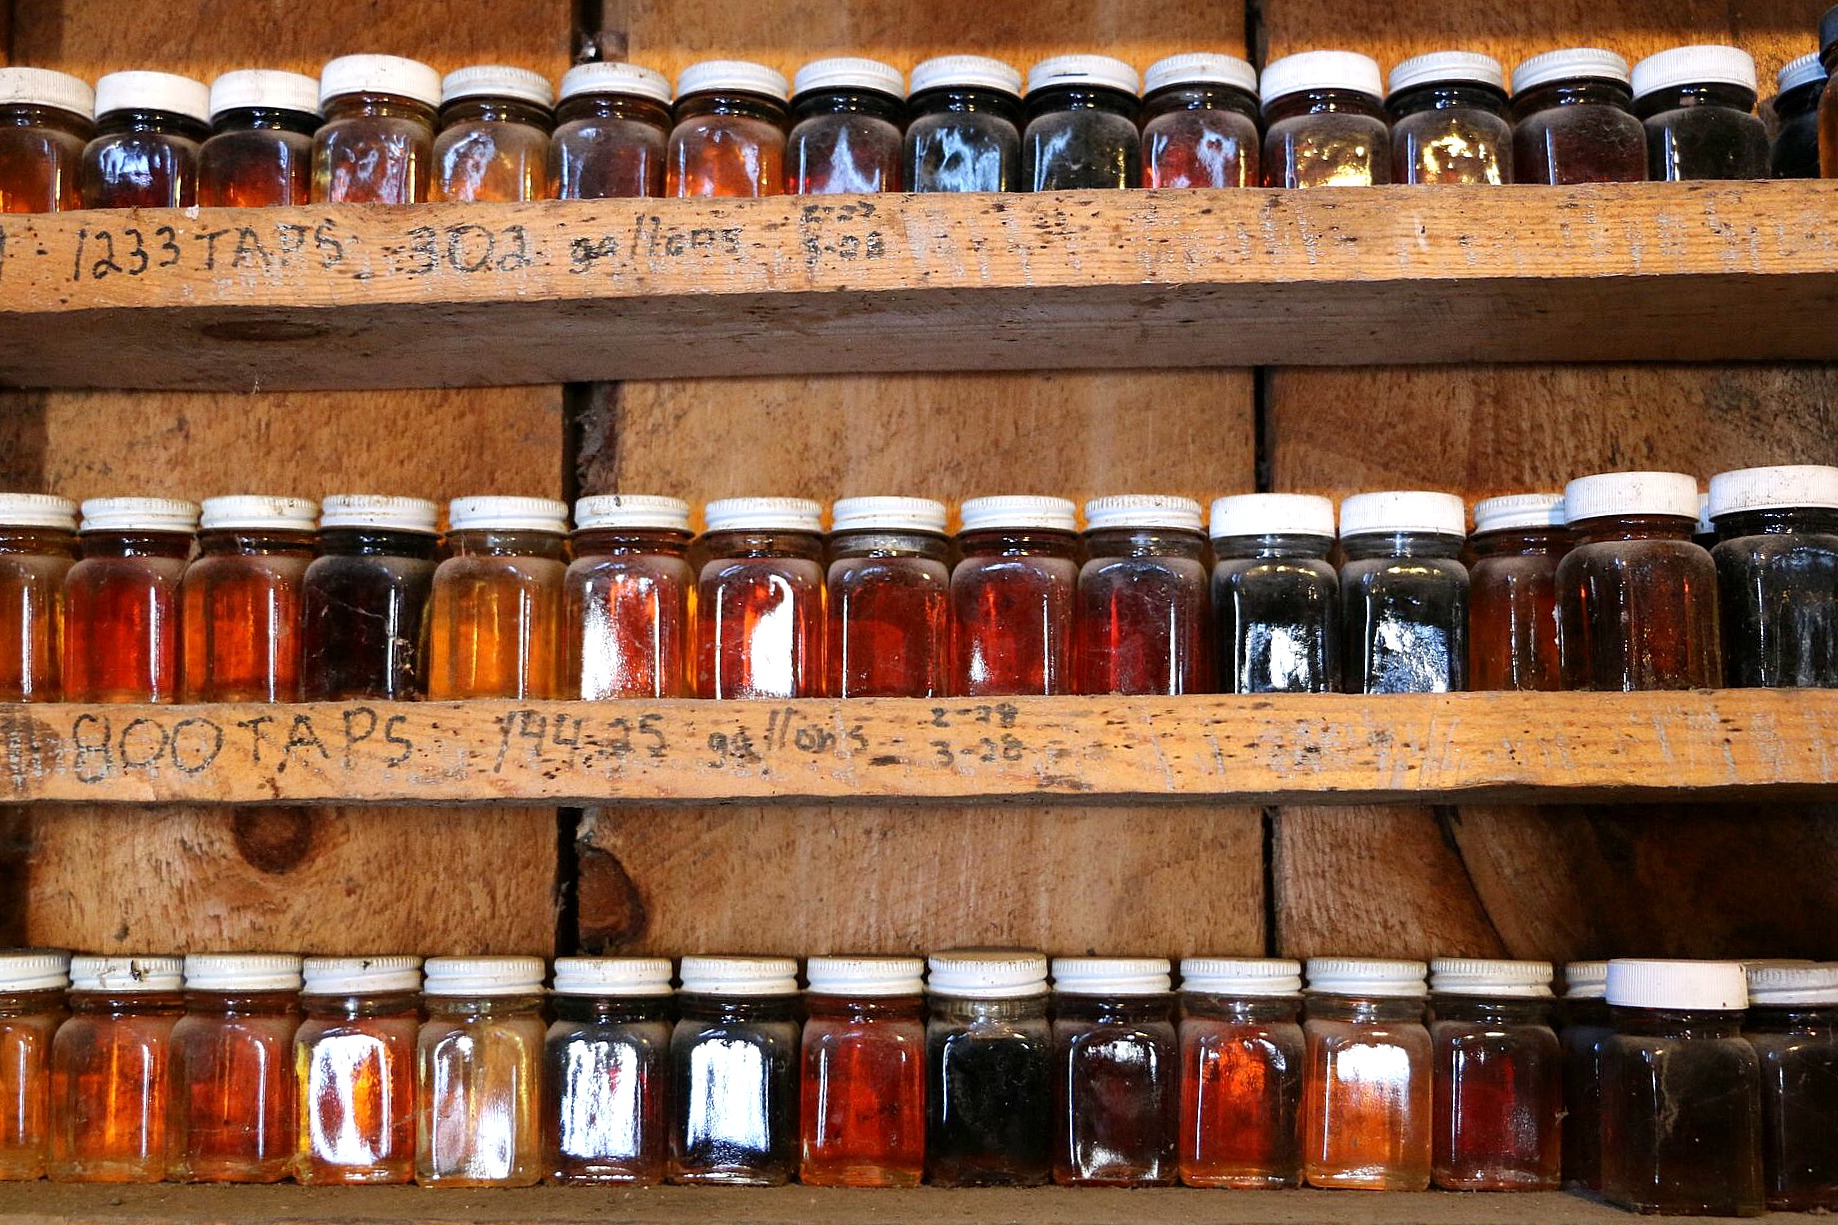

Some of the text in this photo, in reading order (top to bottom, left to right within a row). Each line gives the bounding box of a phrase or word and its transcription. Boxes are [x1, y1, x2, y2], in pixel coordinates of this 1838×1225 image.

[73, 226, 181, 281] 1233
[195, 218, 344, 269] TAPS
[73, 713, 224, 784] 800
[237, 706, 413, 773] TAPS
